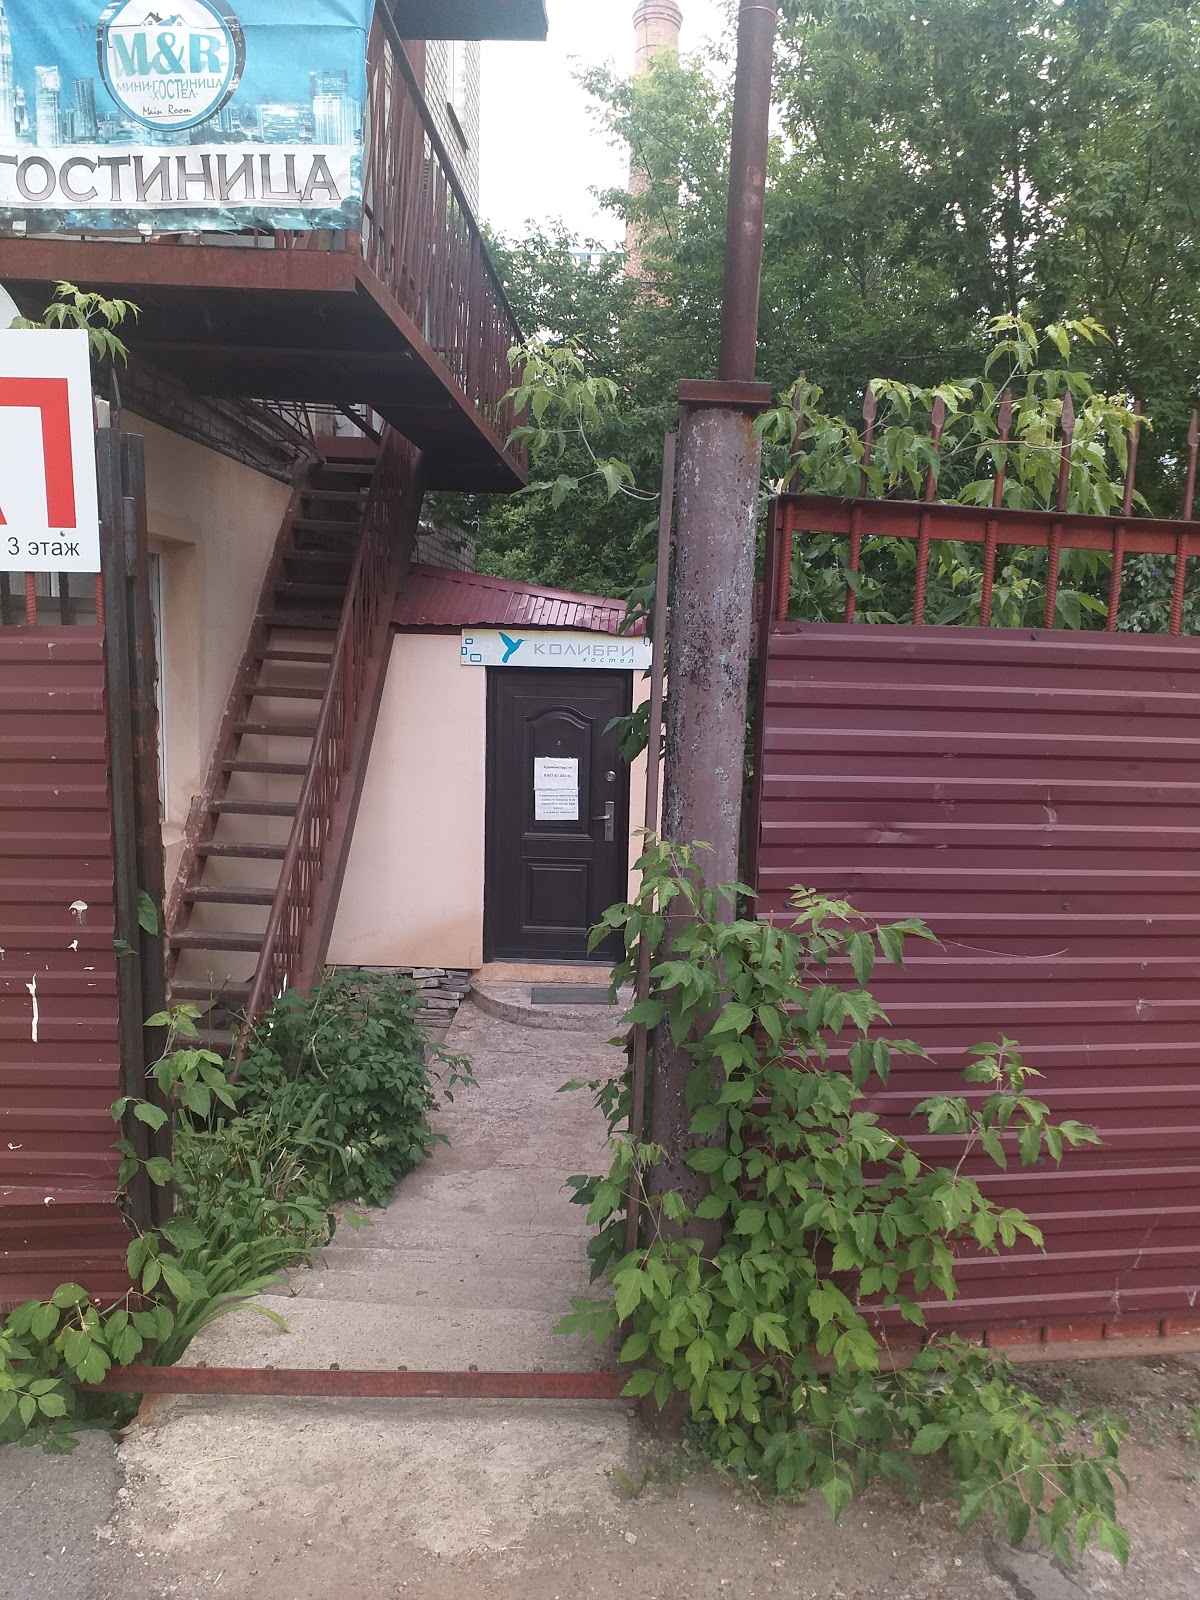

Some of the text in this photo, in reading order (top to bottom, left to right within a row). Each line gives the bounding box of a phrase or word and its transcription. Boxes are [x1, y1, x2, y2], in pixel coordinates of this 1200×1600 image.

[111, 32, 222, 77] M&R
[116, 78, 223, 99] МИНИ-ГОСТИНИЦА
[142, 104, 192, 116] Main Room
[8, 537, 80, 557] 3 этаж
[534, 643, 635, 657] КОЛИБРИ
